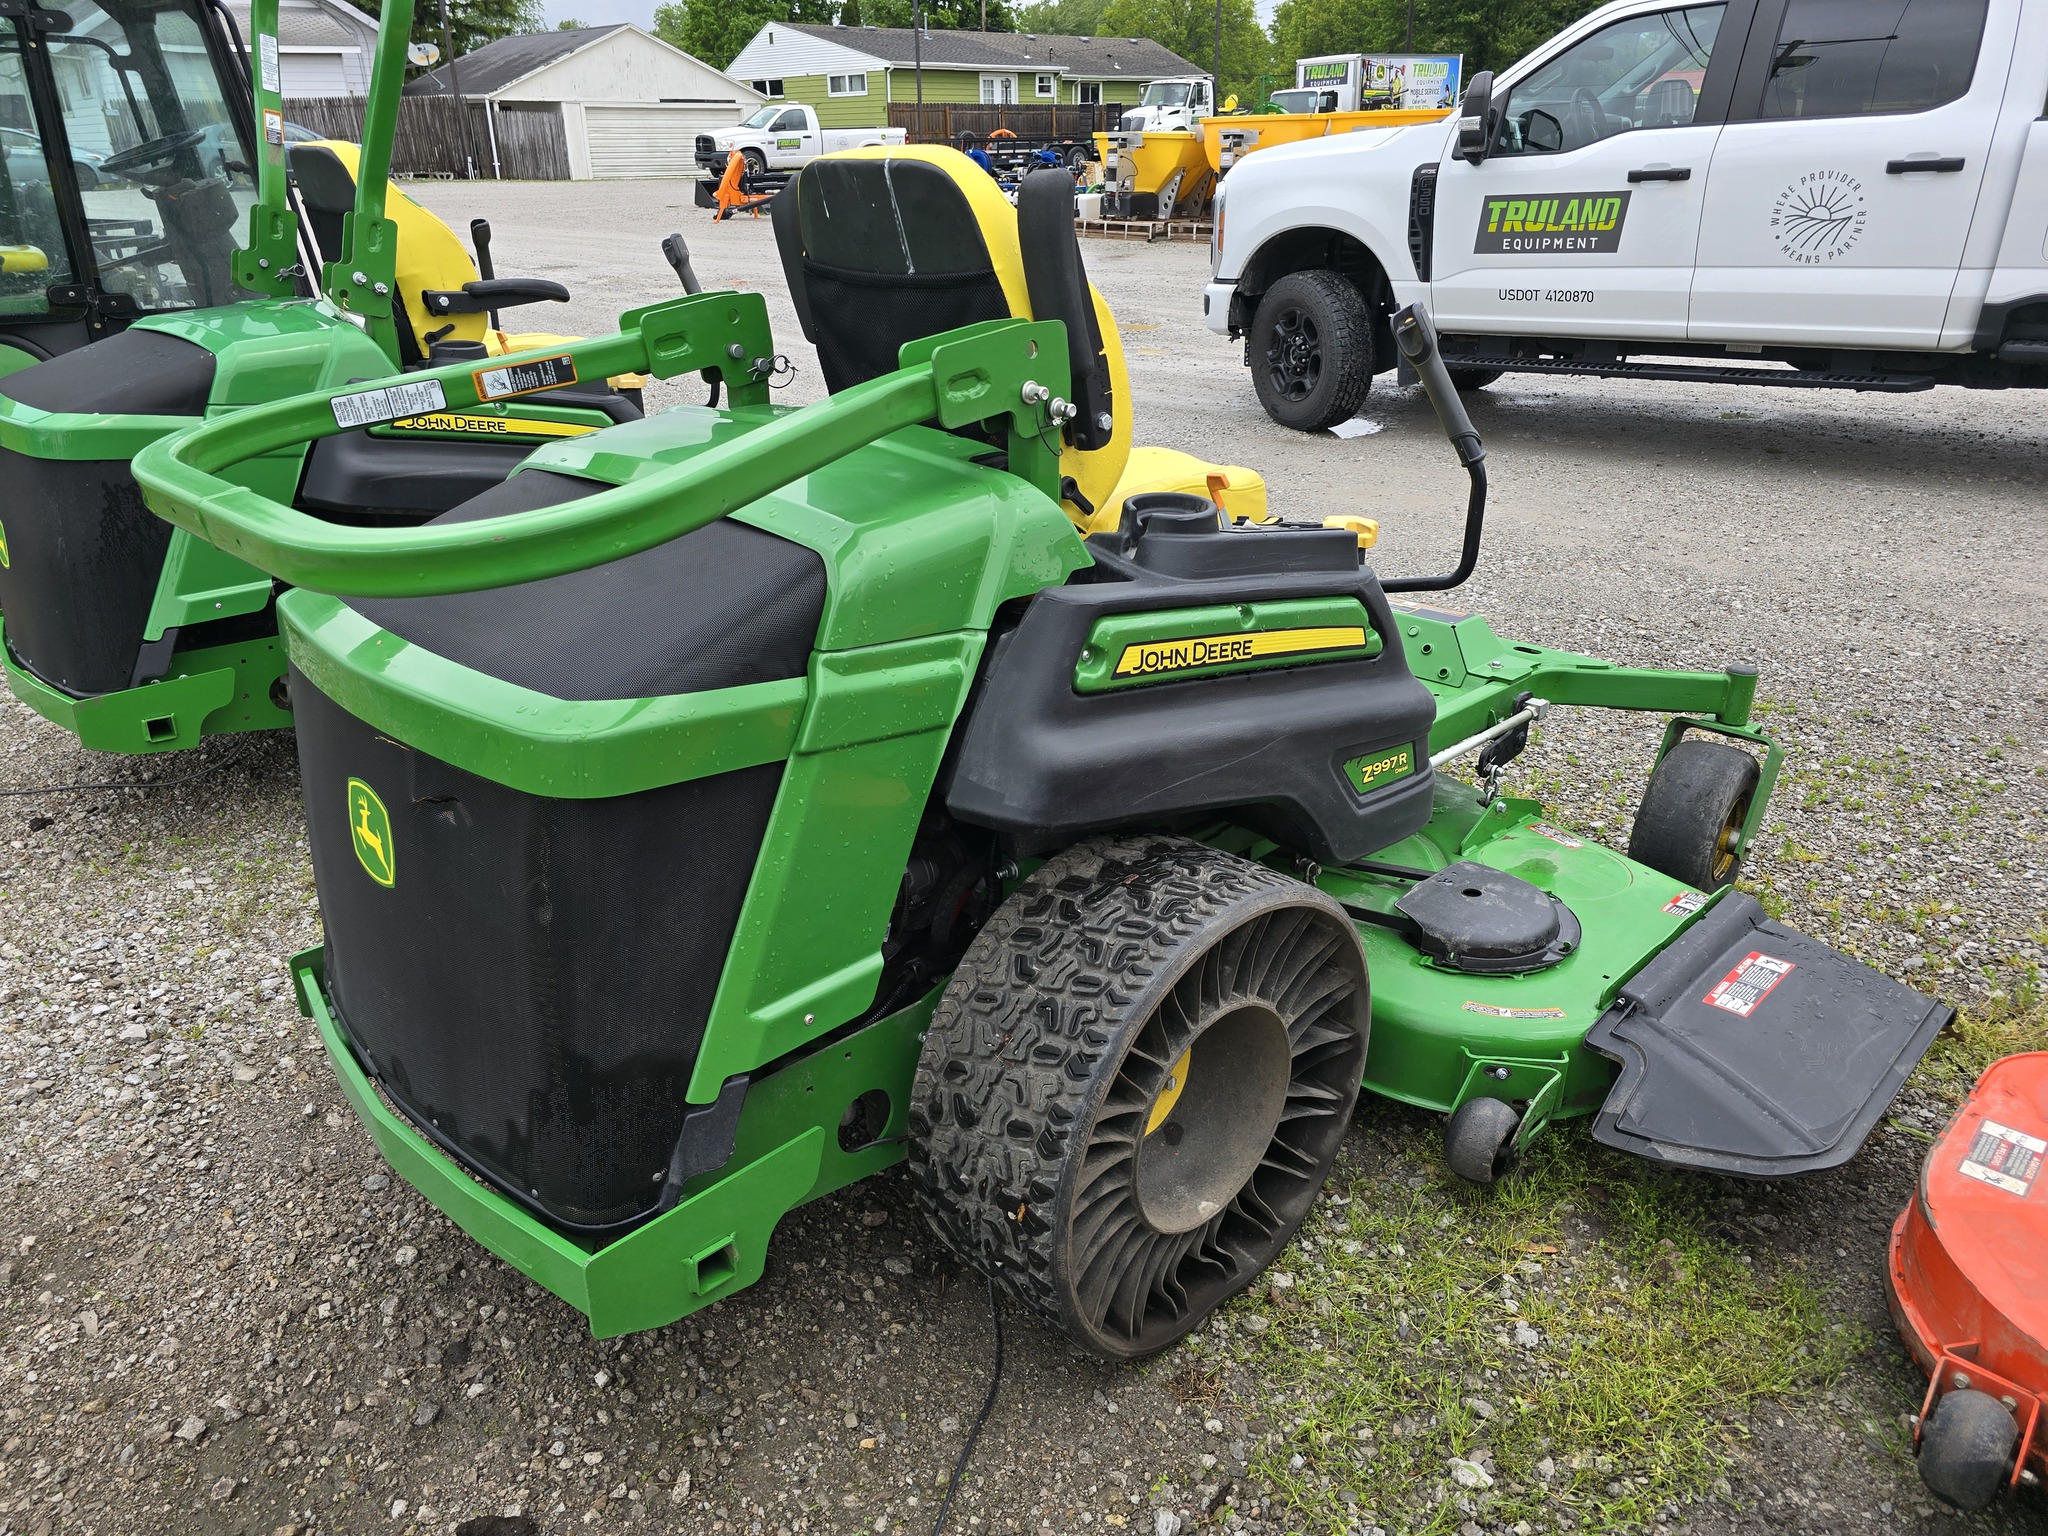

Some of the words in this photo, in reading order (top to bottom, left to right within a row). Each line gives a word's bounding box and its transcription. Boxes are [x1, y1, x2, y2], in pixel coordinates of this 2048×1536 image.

[1306, 63, 1346, 80] TRULAND
[1412, 63, 1448, 78] TRULAND
[1310, 79, 1341, 87] EQUIPMENT
[1410, 88, 1424, 96] MOBILE
[1770, 184, 1796, 227] WHERE
[1800, 170, 1862, 192] PROVIDER
[1487, 197, 1621, 233] TRULAND
[1502, 237, 1599, 251] EQUIPMENT
[1780, 244, 1820, 264] MEANS
[1828, 210, 1867, 260] PARTNER
[1498, 288, 1541, 301] USDOT
[1545, 289, 1594, 303] 4120870
[406, 417, 451, 428] JOHN
[454, 417, 507, 432] DEERE
[1132, 647, 1188, 671] JOHN
[1192, 640, 1254, 663] DEERE
[1362, 752, 1408, 784] Z997R
